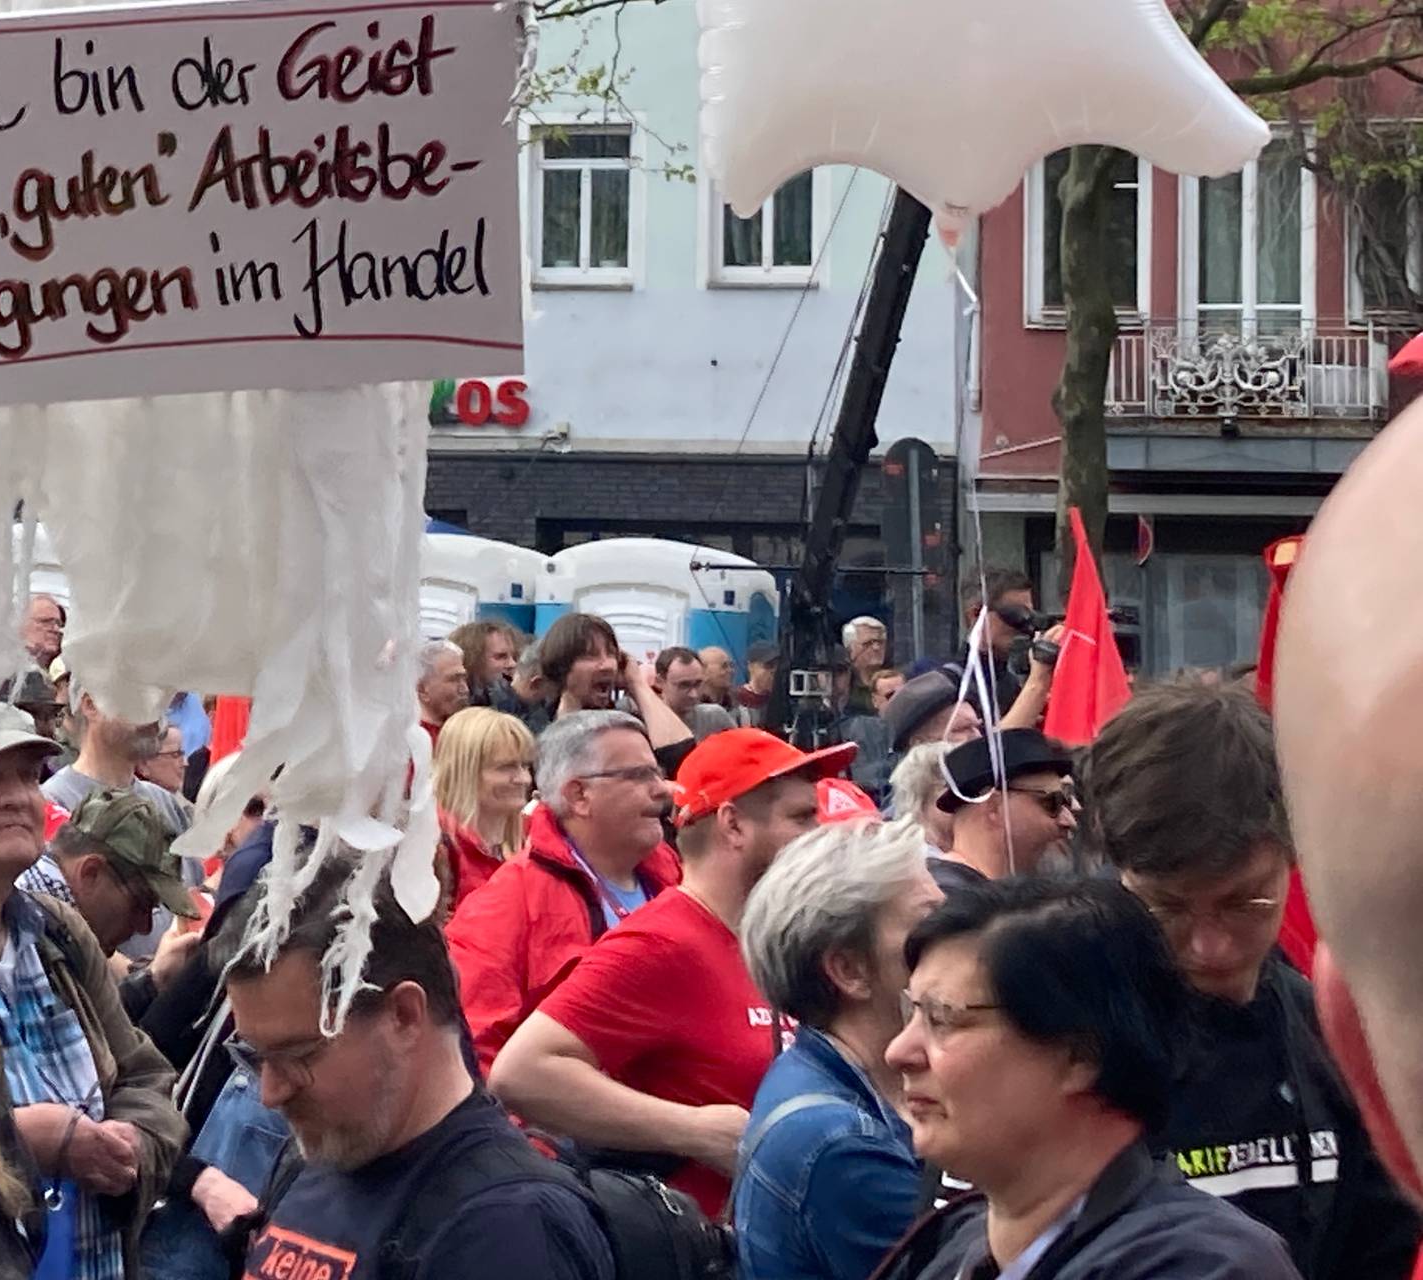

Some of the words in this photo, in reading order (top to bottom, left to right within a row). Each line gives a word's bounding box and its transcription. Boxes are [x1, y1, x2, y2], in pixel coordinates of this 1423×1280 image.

[54, 37, 145, 116] bin
[171, 37, 257, 110] der
[278, 14, 456, 103] Geist
[188, 122, 482, 212] Arbeitsbe-
[210, 231, 281, 305] im
[291, 217, 492, 338] Handel
